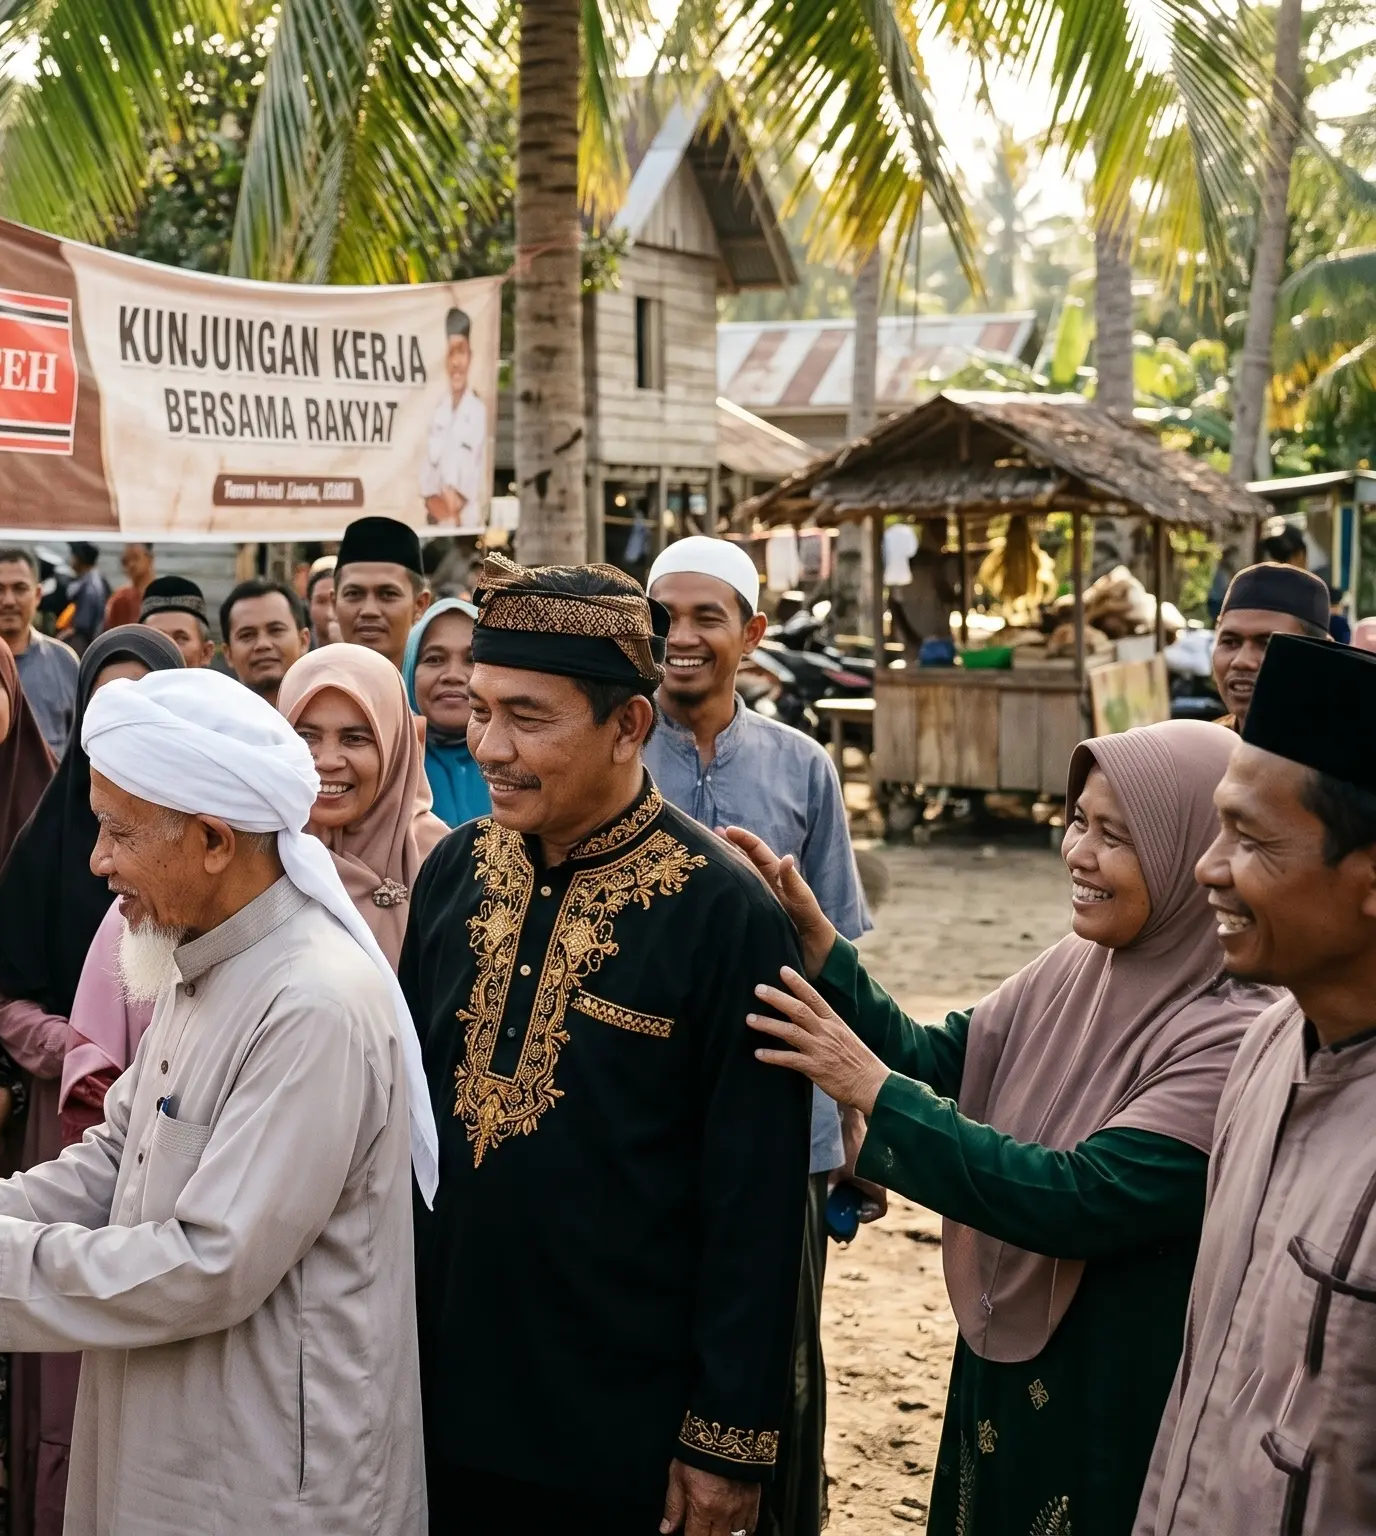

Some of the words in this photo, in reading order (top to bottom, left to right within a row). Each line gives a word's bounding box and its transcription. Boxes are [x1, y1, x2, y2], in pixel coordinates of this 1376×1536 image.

[119, 305, 320, 377] KUNJUNGAN
[332, 328, 427, 383] KERJA
[164, 387, 298, 440] BERSAMA
[304, 398, 398, 443] RAKYAT
